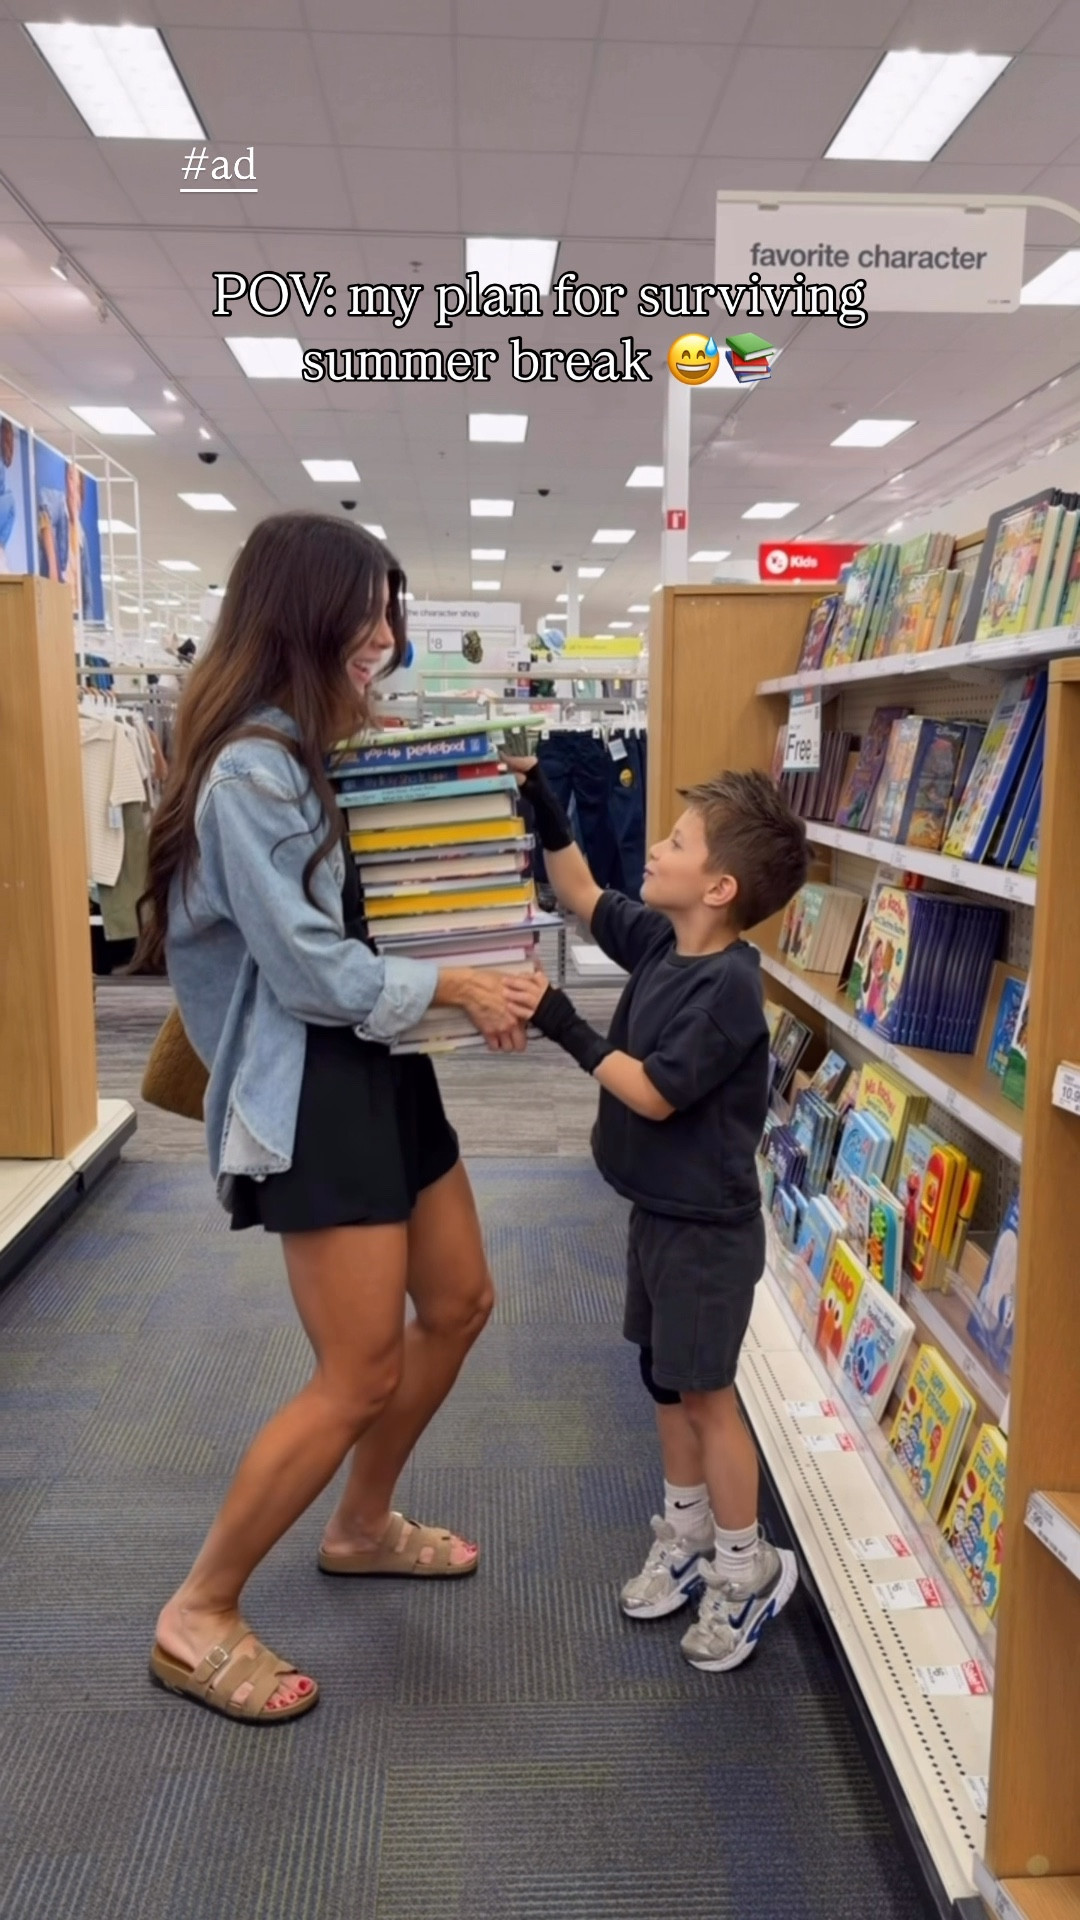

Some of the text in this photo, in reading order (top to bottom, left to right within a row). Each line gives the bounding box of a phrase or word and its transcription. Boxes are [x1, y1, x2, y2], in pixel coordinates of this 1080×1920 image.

[750, 243, 988, 270] favorite character
[790, 555, 819, 568] Kids
[420, 608, 458, 617] character
[460, 608, 480, 618] shop
[786, 733, 812, 761] Free
[830, 1257, 857, 1305] ELMO
